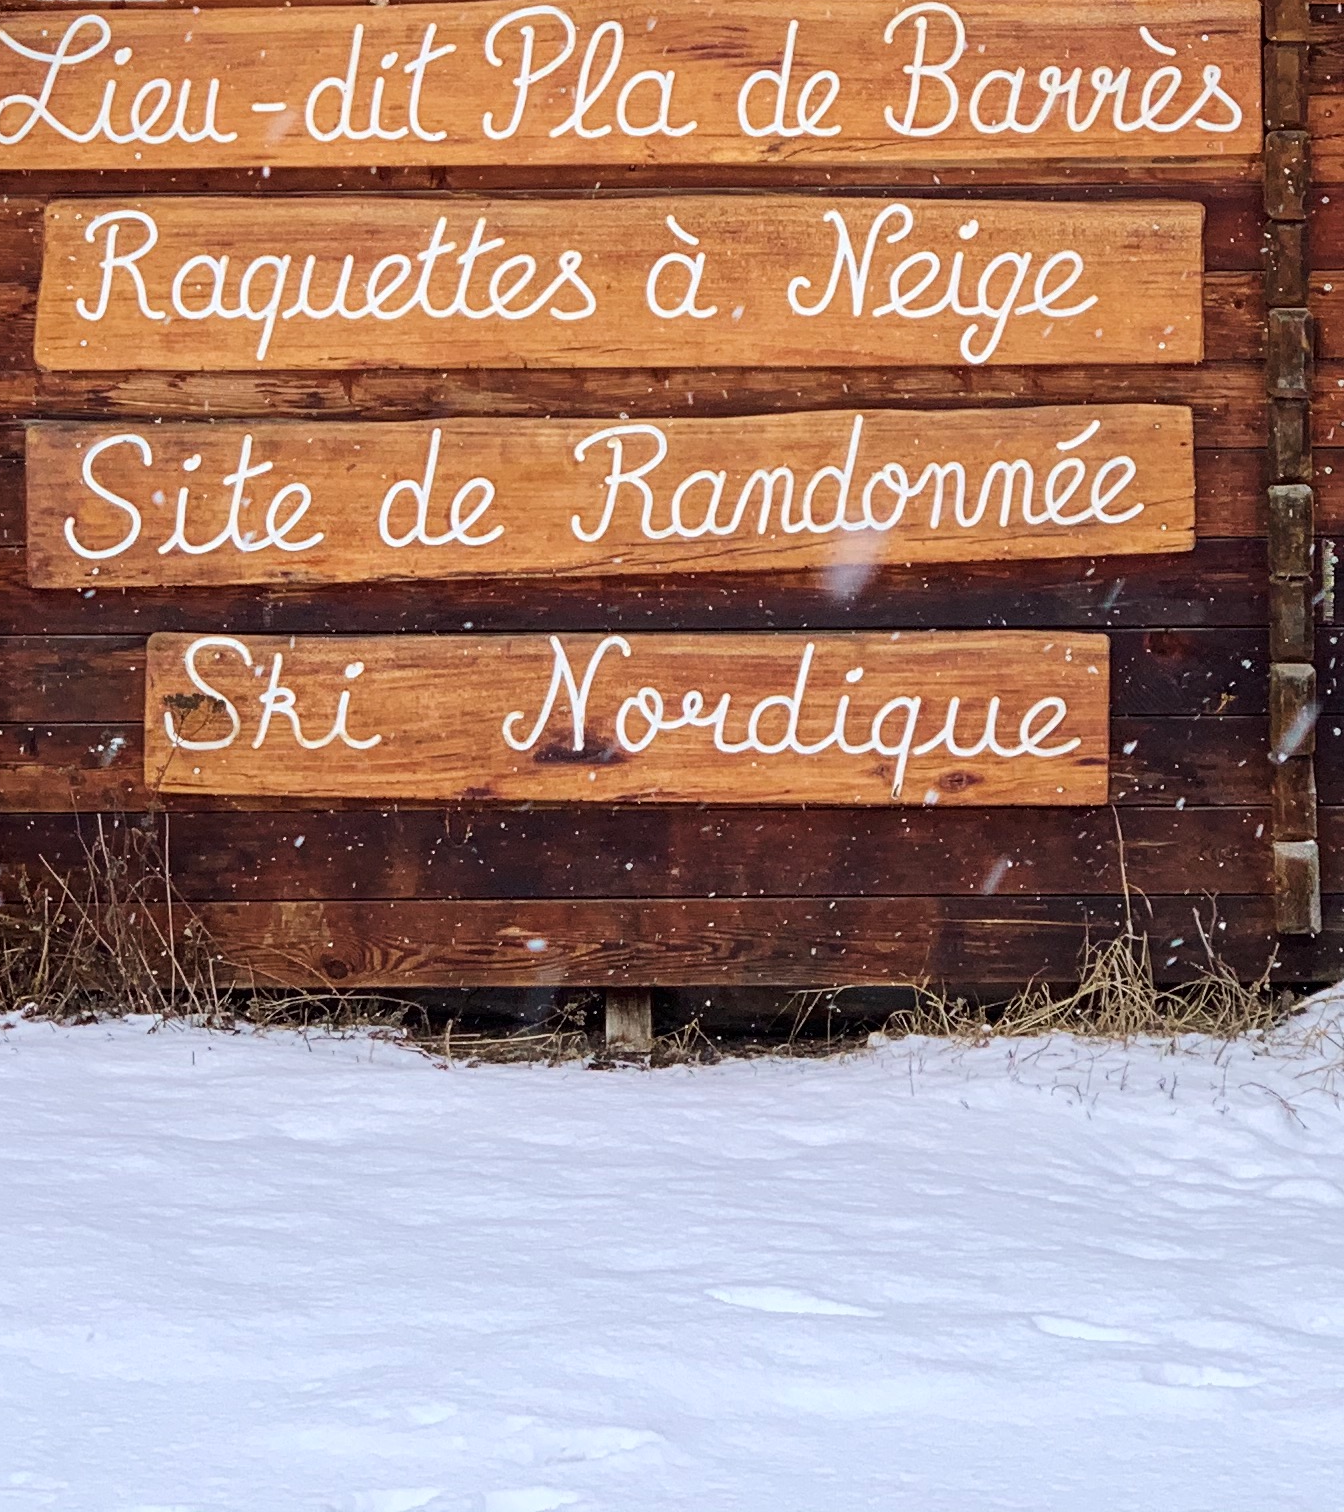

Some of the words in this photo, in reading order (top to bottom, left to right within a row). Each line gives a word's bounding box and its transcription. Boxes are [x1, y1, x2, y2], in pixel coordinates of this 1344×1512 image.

[483, 5, 697, 140] Pla
[737, 19, 842, 138] de
[884, 2, 1243, 137] Barrès
[76, 209, 597, 361] Raquettes
[646, 215, 718, 319] à
[787, 203, 1098, 365] Neige
[63, 433, 325, 560] Site
[378, 427, 504, 548] de
[570, 414, 1145, 545] Randonnée
[163, 636, 382, 751] Ski
[503, 634, 1081, 800] Nordique
